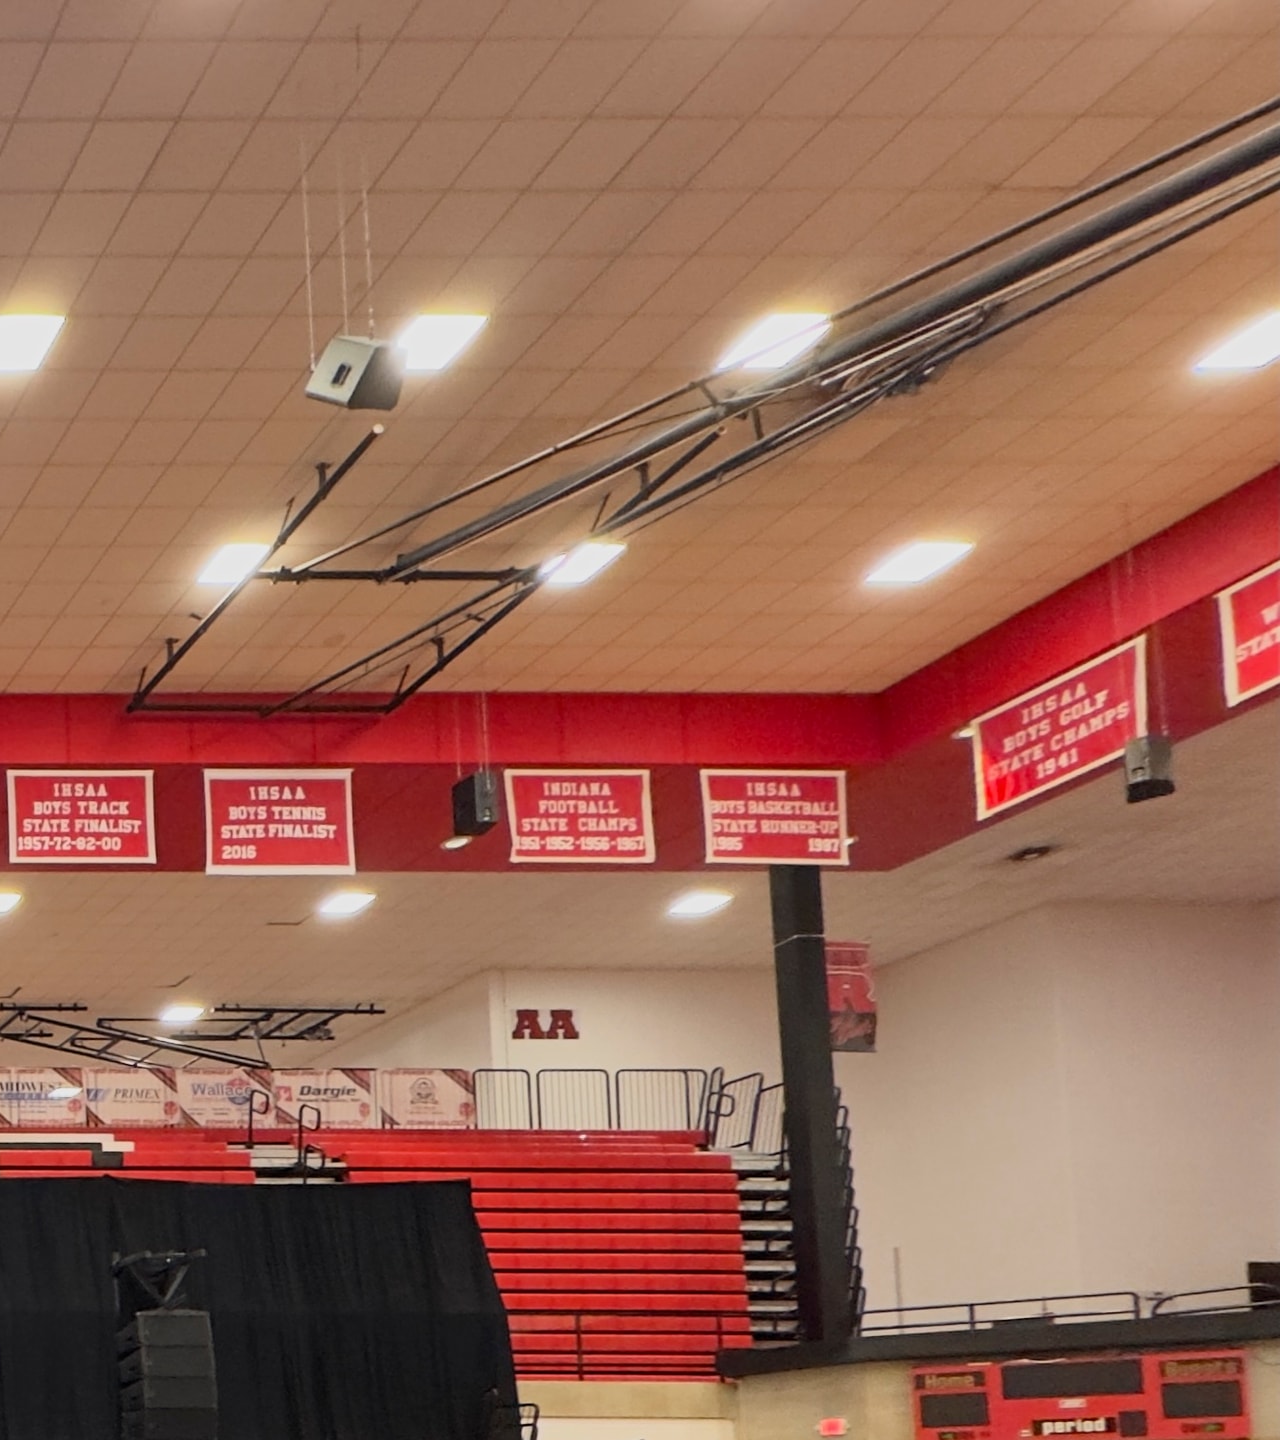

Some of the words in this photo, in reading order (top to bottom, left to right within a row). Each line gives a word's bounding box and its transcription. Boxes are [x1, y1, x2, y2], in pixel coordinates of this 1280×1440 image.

[1021, 682, 1087, 725] IHSAA
[1003, 719, 1051, 753] BOYS
[1059, 689, 1109, 726] GOLF
[987, 744, 1045, 780] STATE
[1050, 701, 1130, 751] CHAMPS
[1036, 748, 1079, 780] 1941
[53, 783, 108, 798] IHSAA
[248, 786, 306, 801] IHSAA
[543, 782, 611, 796] INDIANA
[746, 782, 801, 797] IHSAA
[33, 801, 72, 816] BOYS
[77, 801, 130, 816] TRACK
[228, 806, 267, 821] BOYS
[271, 806, 327, 821] TENNIS
[538, 800, 619, 814] FOOTBALL
[710, 800, 746, 814] BOYS
[747, 801, 839, 815] BASKETBALL
[22, 818, 70, 833] STATE
[74, 818, 142, 834] FINALIST
[221, 824, 266, 839] STATE
[268, 824, 337, 839] FINALIST
[521, 818, 569, 832] STATE
[578, 817, 637, 832] CHAMPS
[712, 819, 757, 833] STATE
[760, 820, 838, 834] RUNNER-UP
[222, 844, 257, 860] 2016
[512, 1010, 579, 1040] AA
[113, 1088, 161, 1099] PRIMEX
[192, 1083, 253, 1097] Wallace
[299, 1085, 357, 1099] Dargie
[1041, 1417, 1106, 1436] period
